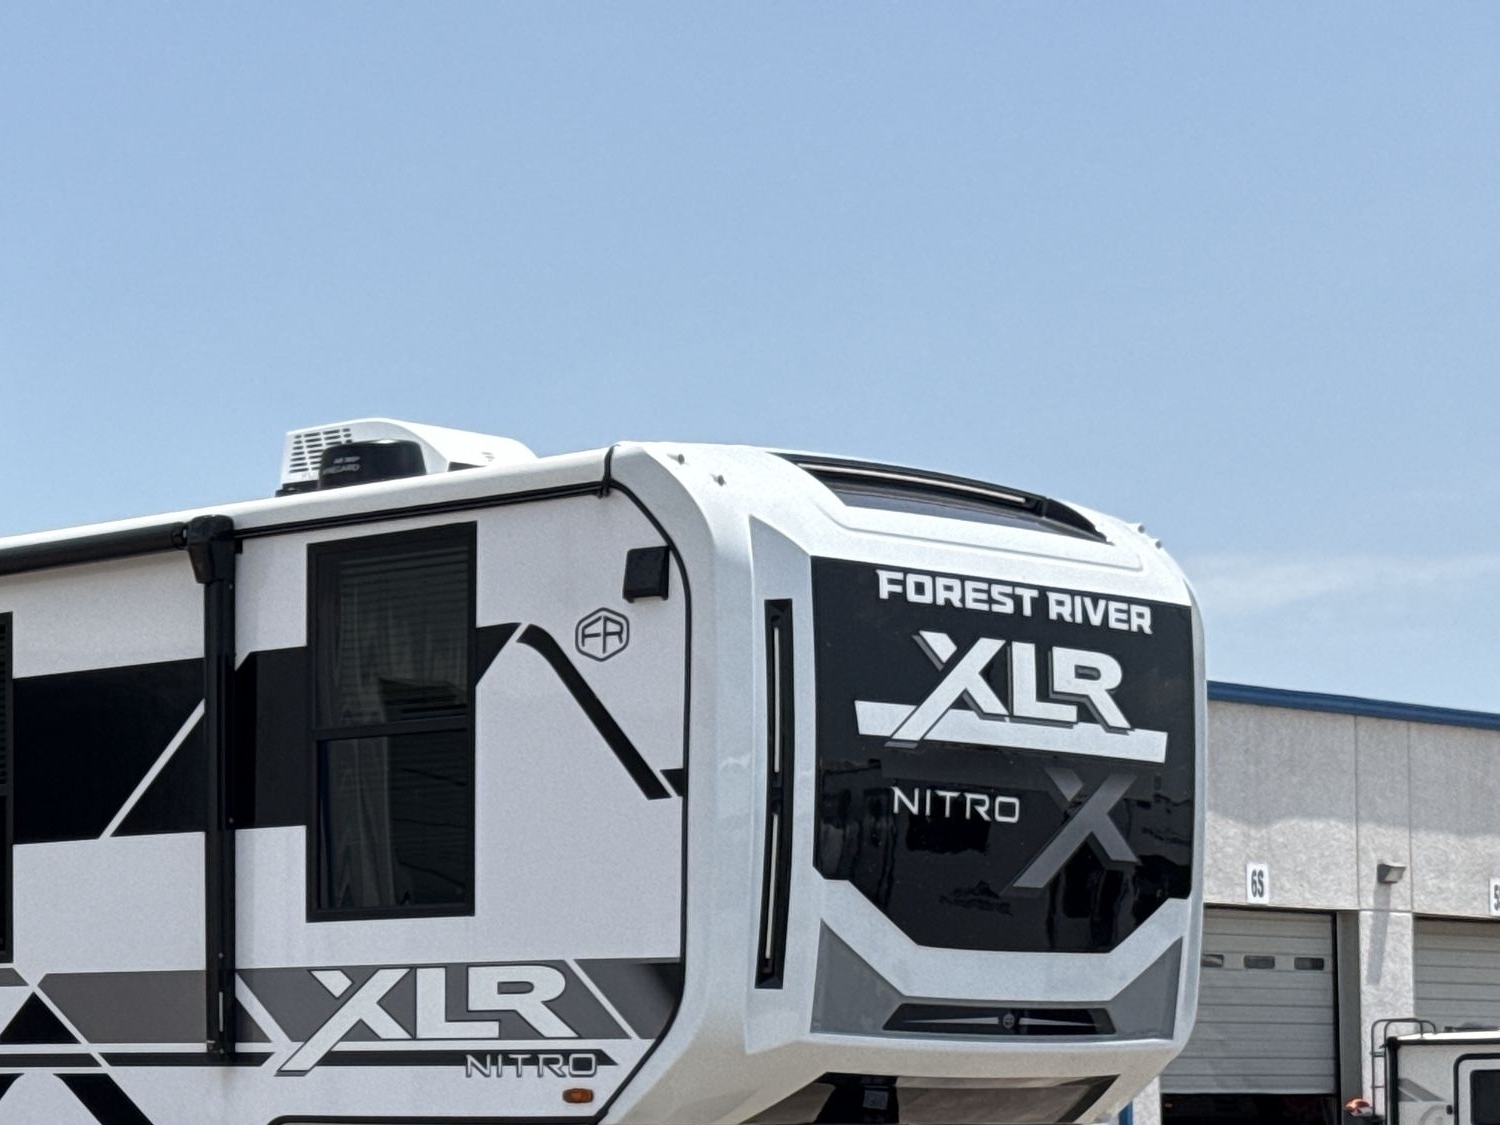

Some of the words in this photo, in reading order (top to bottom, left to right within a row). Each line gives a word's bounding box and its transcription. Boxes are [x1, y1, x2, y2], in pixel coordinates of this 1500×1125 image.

[876, 569, 1039, 617] FOREST
[1046, 591, 1153, 634] RIVER
[884, 630, 1135, 749] XLR
[890, 785, 1020, 824] NITRO
[1251, 869, 1264, 898] 6S
[1493, 884, 1500, 911] 5
[276, 964, 579, 1076] XLR
[465, 1053, 598, 1078] NITRO
